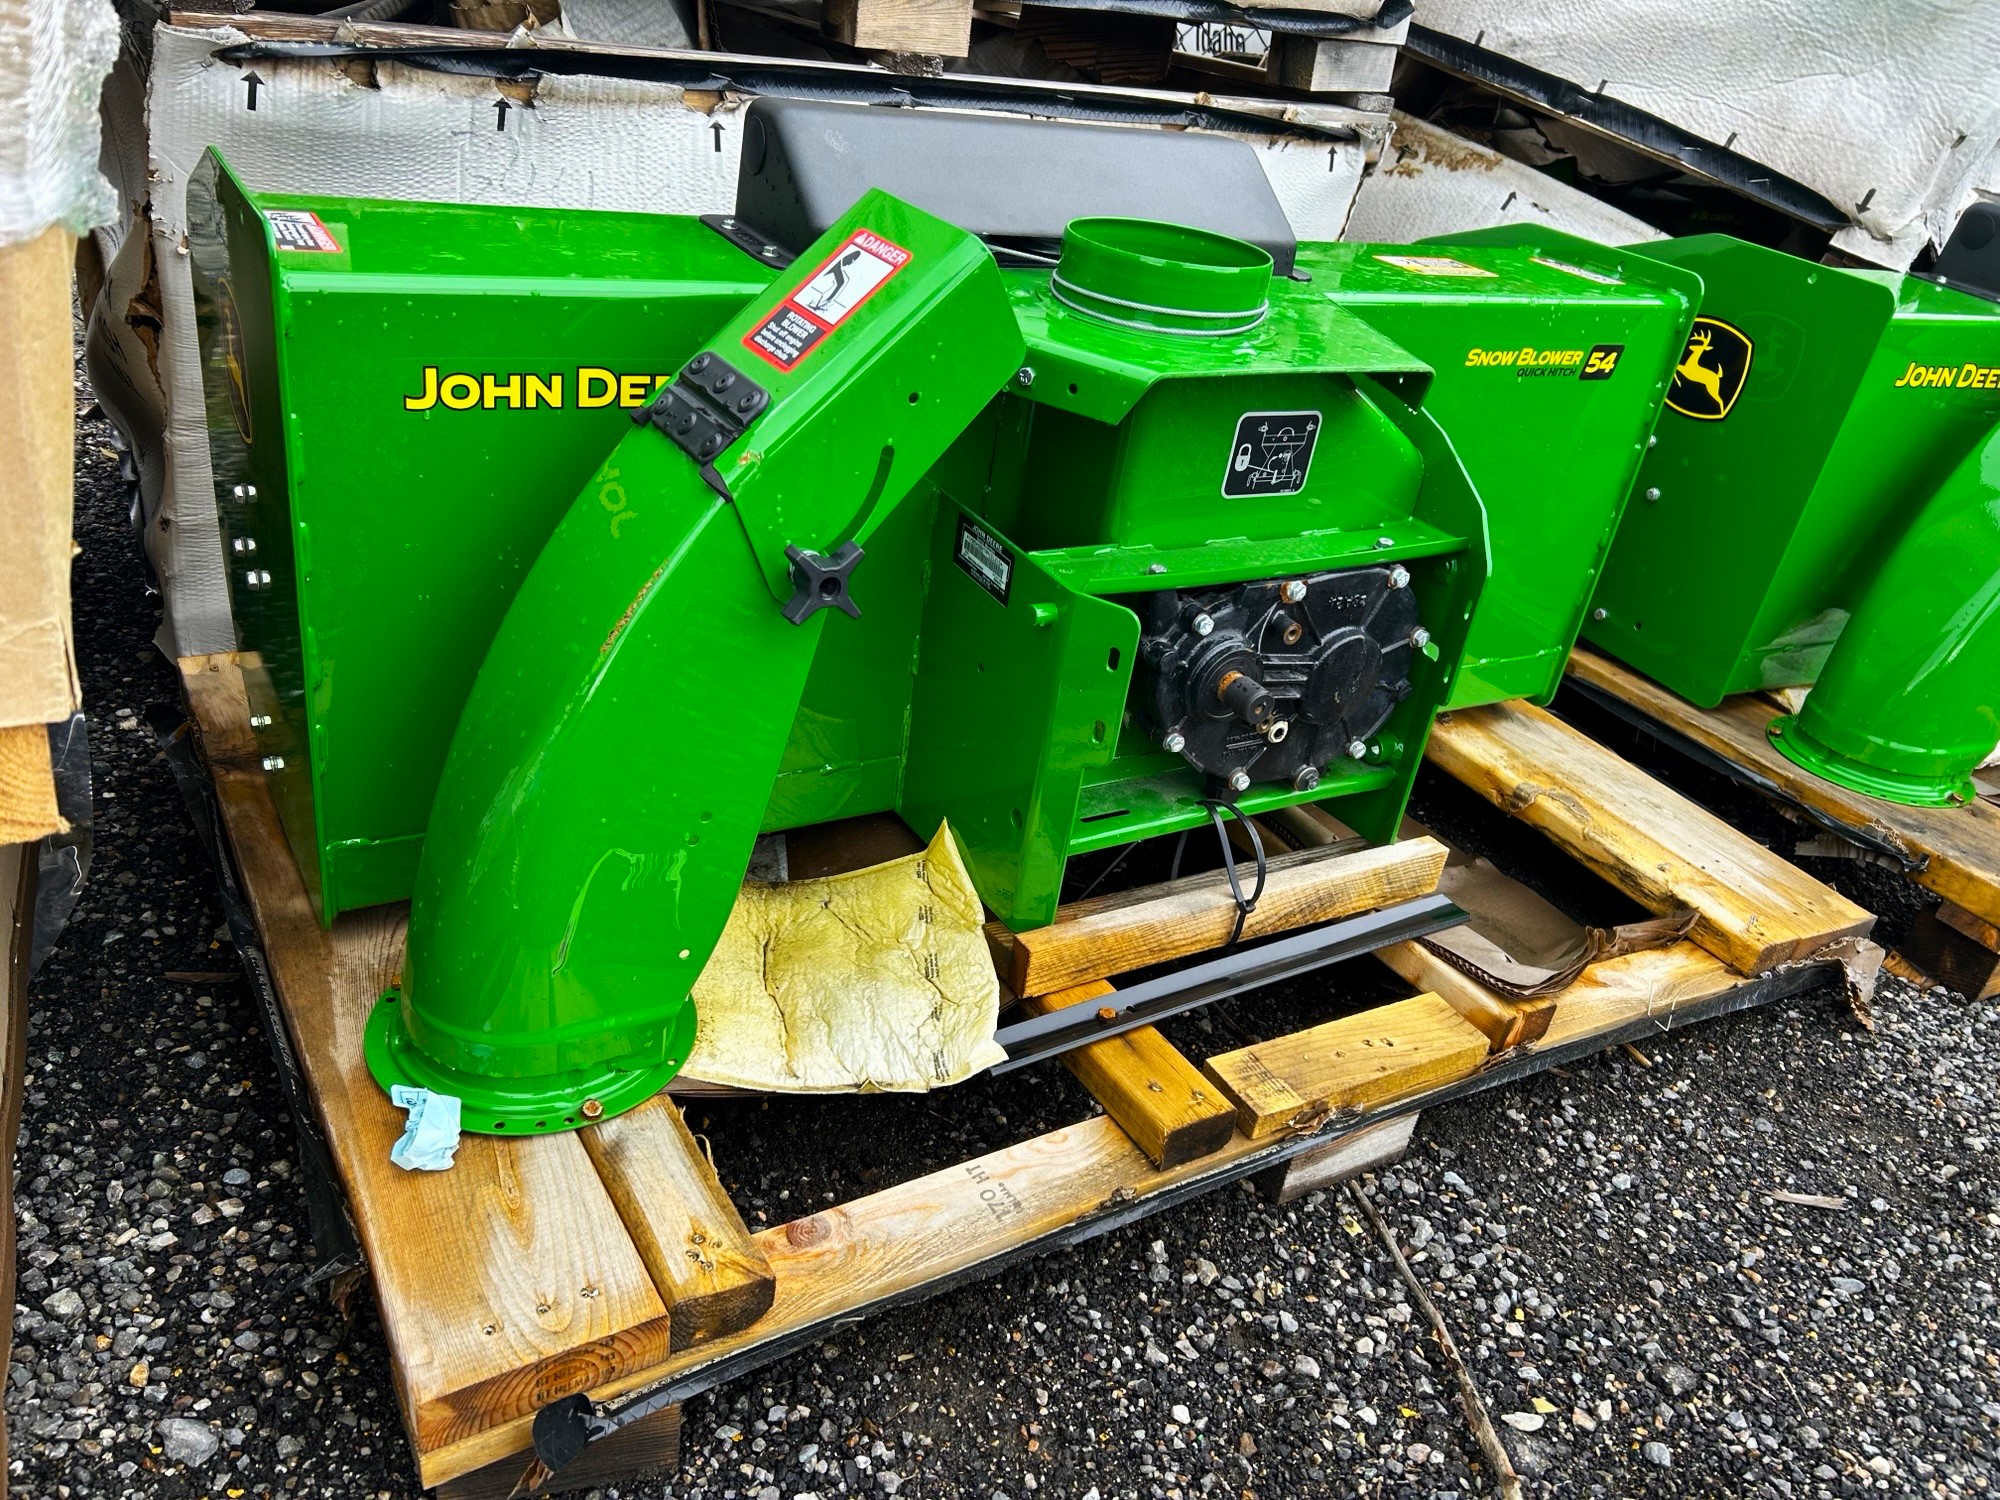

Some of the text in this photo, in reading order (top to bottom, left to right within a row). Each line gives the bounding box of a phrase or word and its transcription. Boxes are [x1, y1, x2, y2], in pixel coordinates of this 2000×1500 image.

[864, 234, 907, 265] DANGER
[781, 319, 808, 339] BLOWER
[786, 311, 817, 333] ROTATING
[1465, 347, 1618, 373] SNOW BLOWER 54
[1516, 367, 1577, 377] QUICK HITCH
[1894, 361, 2000, 388] JOHN DEE
[404, 366, 672, 411] JOHN DE
[972, 524, 986, 539] JOHN
[986, 534, 1003, 552] DEERE
[965, 1165, 990, 1184] HT
